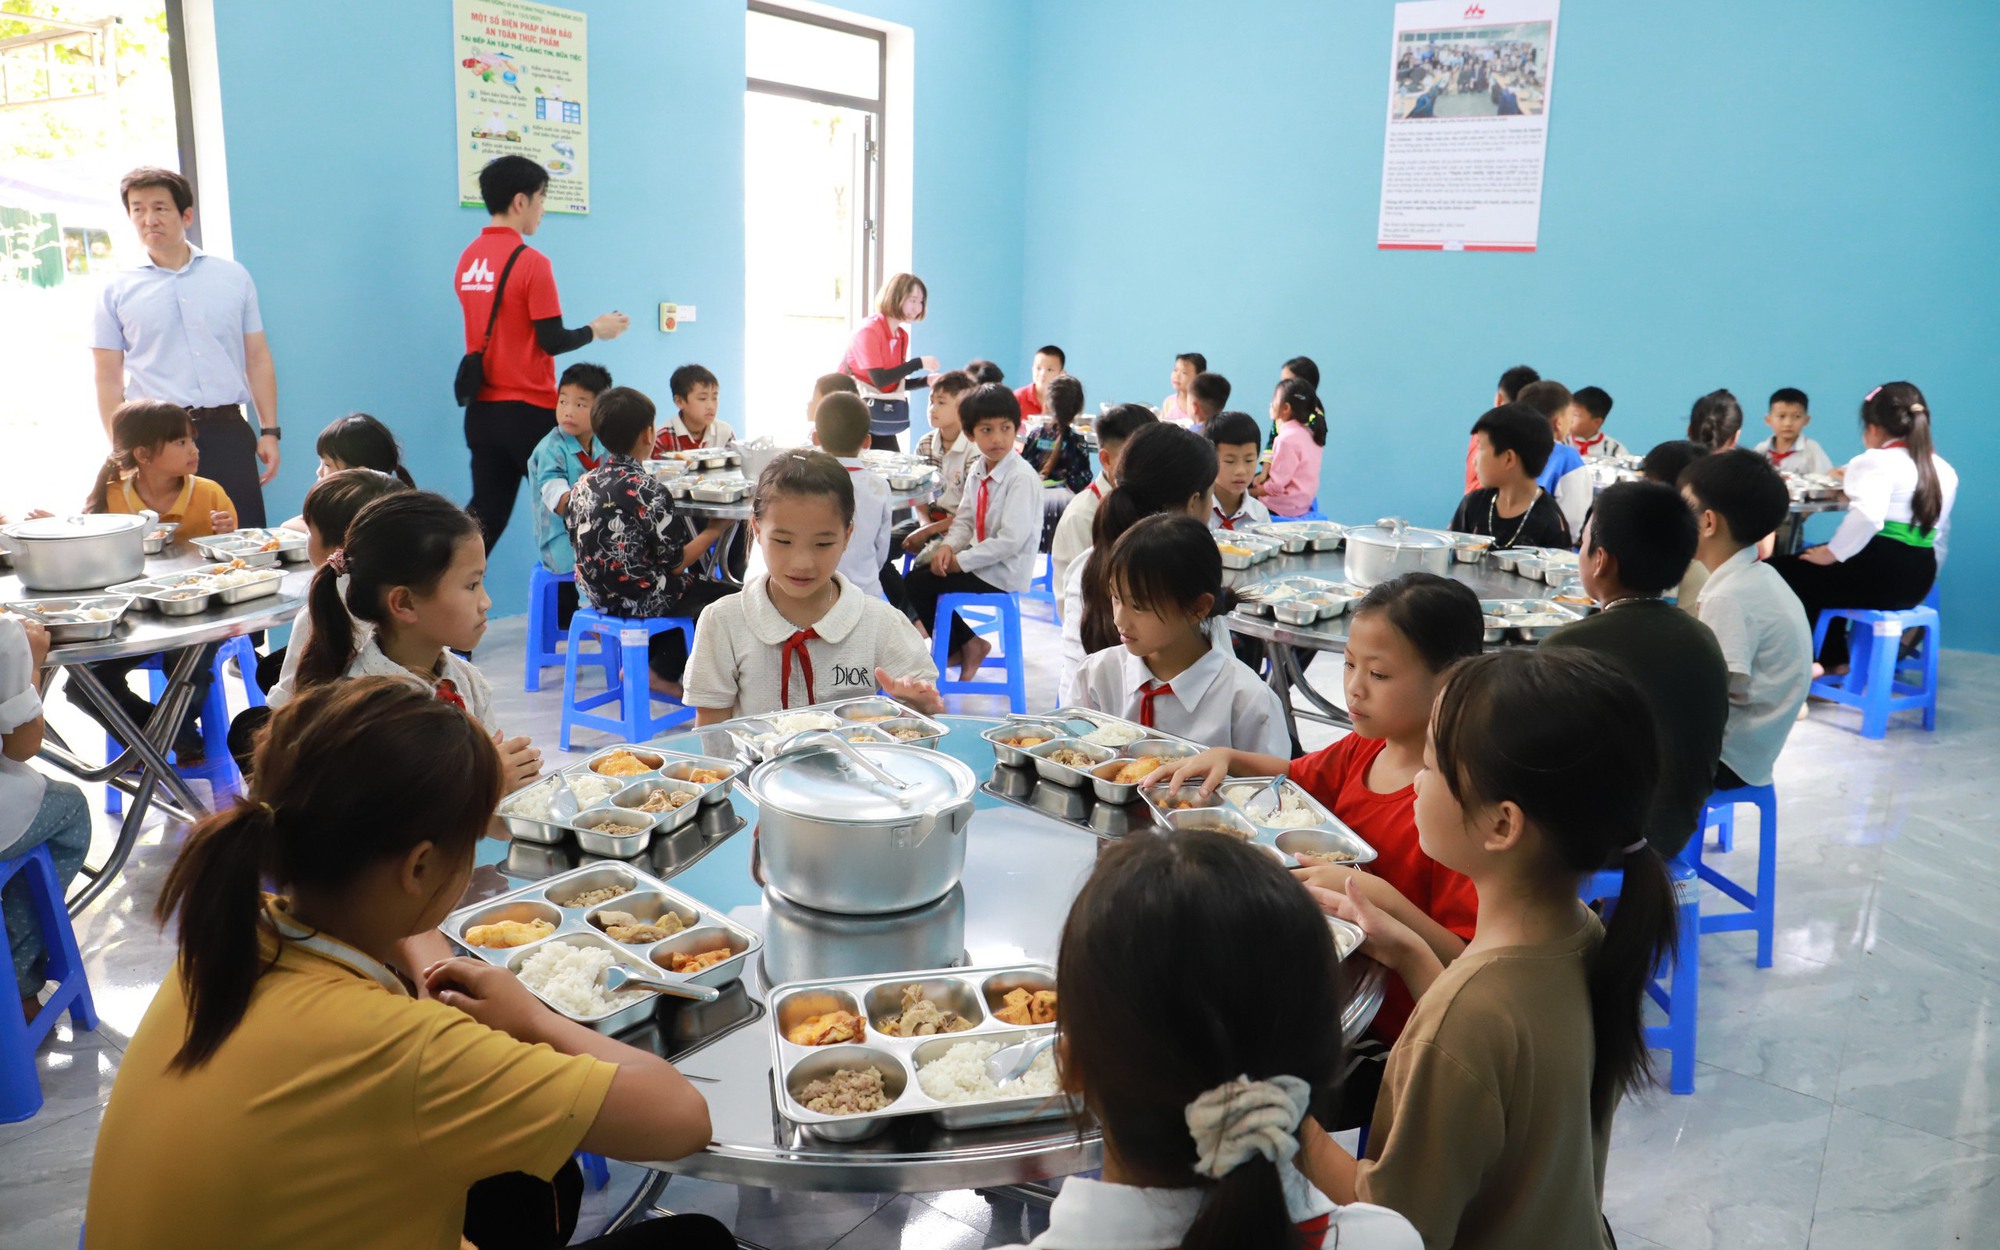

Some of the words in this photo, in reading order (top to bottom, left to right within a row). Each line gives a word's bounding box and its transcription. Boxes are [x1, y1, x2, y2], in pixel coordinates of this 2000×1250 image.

[471, 12, 487, 22] MỘT
[490, 16, 500, 25] SỐ
[502, 18, 518, 28] BIỆN
[520, 21, 539, 32] PHÁP
[540, 24, 556, 35] ĐẢM
[559, 28, 572, 38] BẢO
[486, 27, 496, 36] AN
[498, 29, 516, 40] TOÀN
[519, 33, 536, 44] THỰC
[539, 35, 560, 47] PHẨM
[832, 664, 872, 687] DIOR
